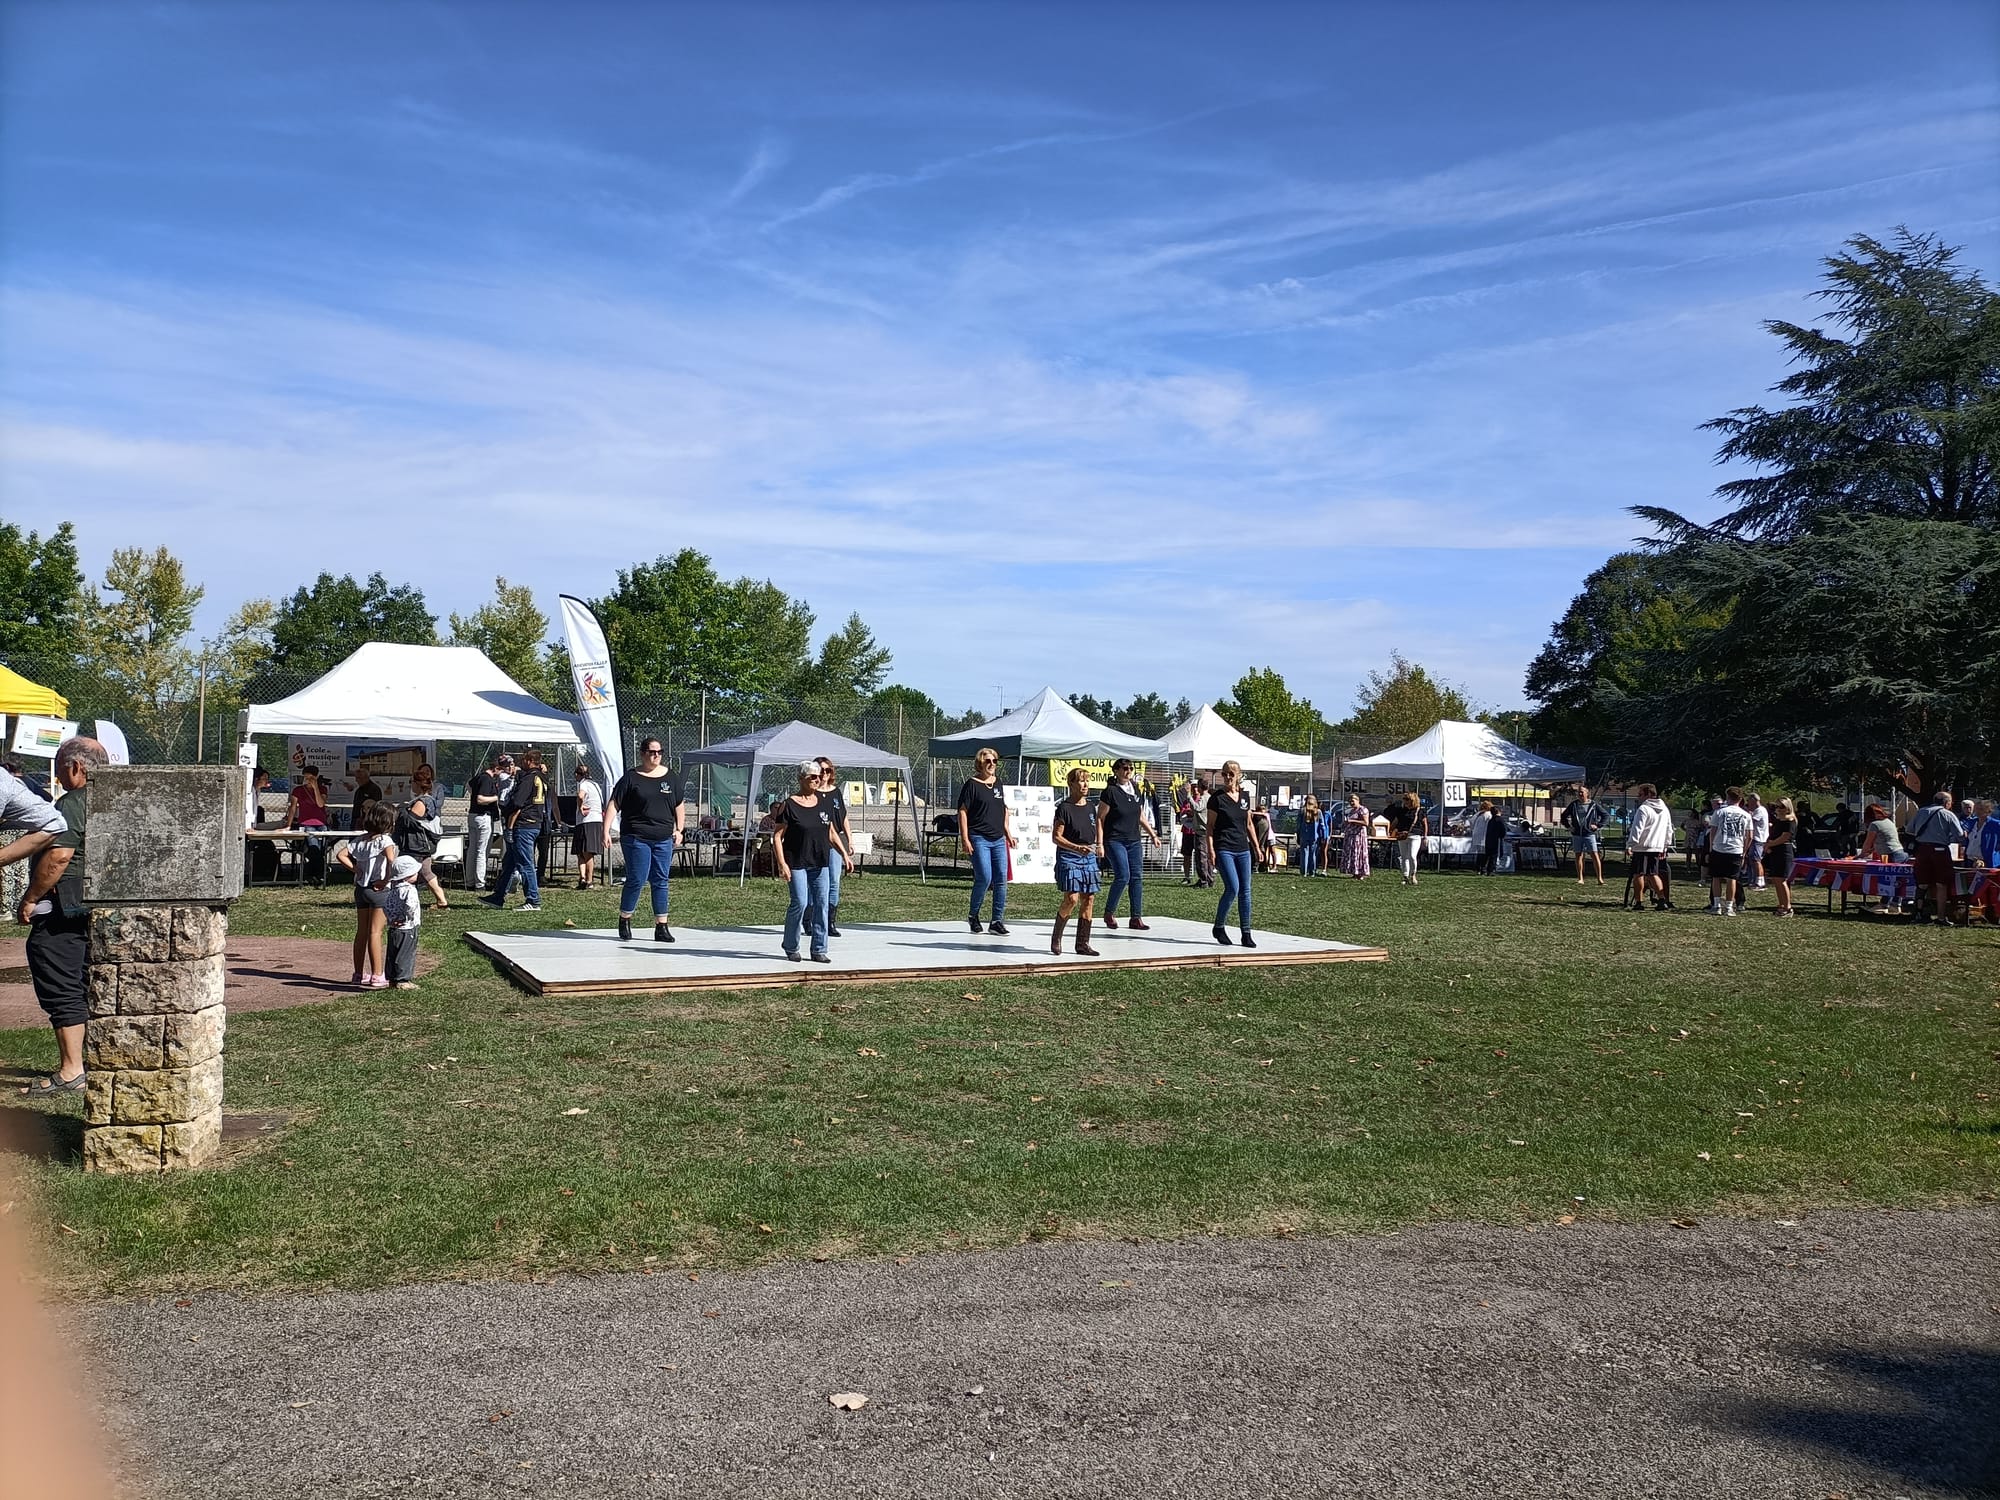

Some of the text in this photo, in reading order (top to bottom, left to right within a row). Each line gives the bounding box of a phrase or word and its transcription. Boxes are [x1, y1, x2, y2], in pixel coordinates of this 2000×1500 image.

[1079, 759, 1105, 768] CLUB
[1344, 781, 1367, 793] SEL
[1388, 783, 1408, 794] SEL
[1446, 785, 1465, 801] SEL
